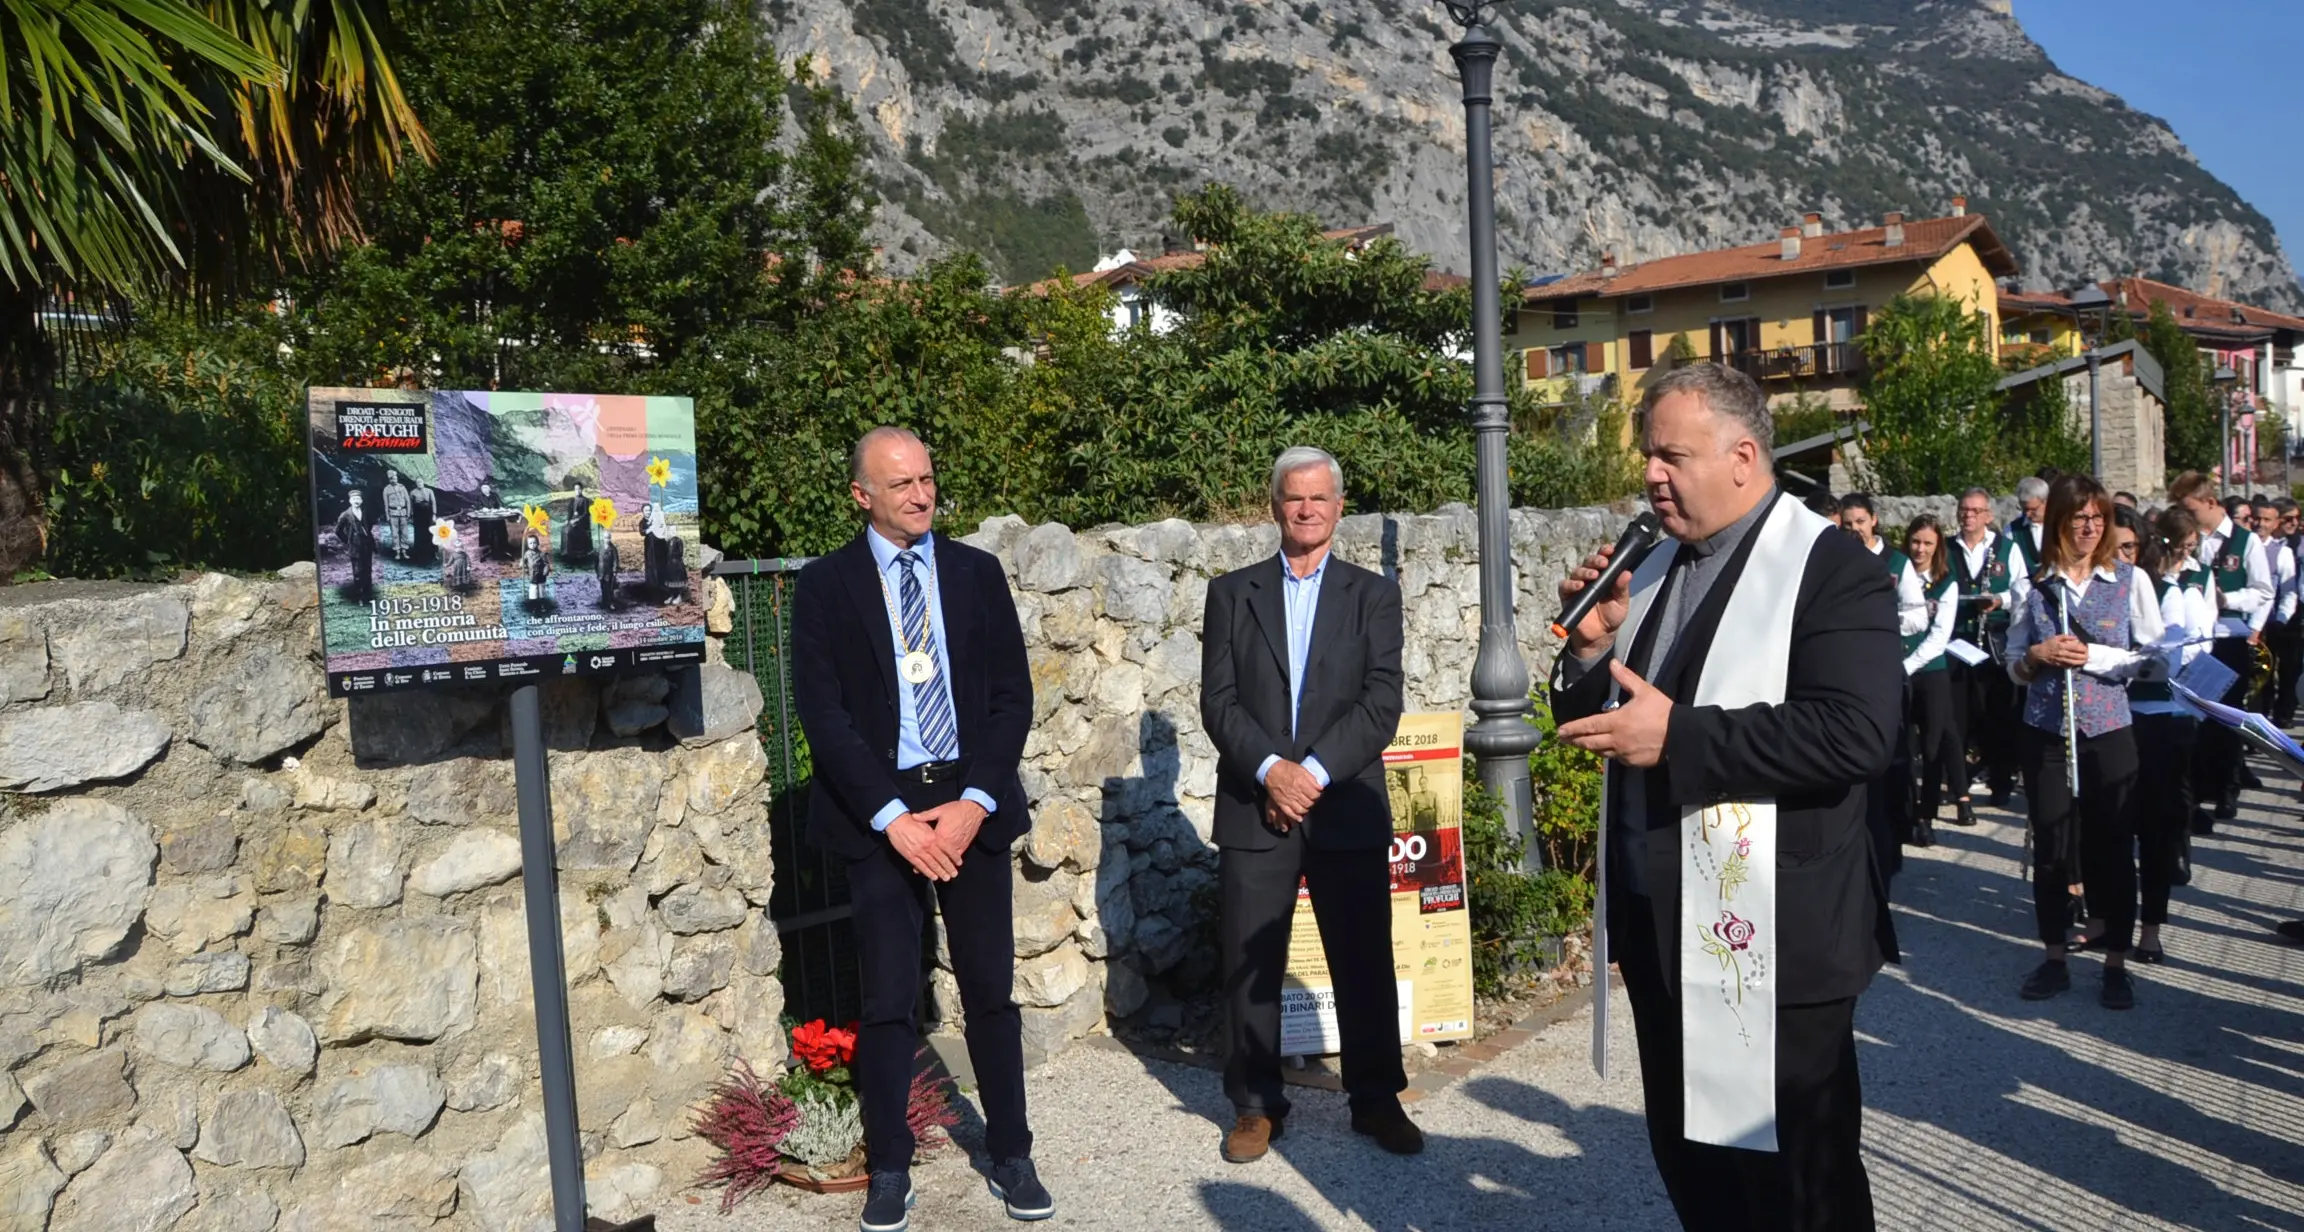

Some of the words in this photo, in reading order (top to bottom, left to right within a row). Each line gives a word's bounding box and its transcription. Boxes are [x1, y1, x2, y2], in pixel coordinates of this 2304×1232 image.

[346, 407, 375, 416] DROATI
[379, 408, 415, 417] CENIGOTI
[339, 415, 373, 424] DRENOTI
[345, 423, 419, 437] PROFUGHI
[369, 595, 462, 616] 1915-1918
[369, 616, 390, 632] In
[395, 611, 476, 630] memoria
[526, 616, 543, 625] che
[544, 613, 605, 624] affrontarono,
[371, 630, 417, 648] delle
[422, 623, 509, 644] Comunità
[527, 628, 544, 637] con
[545, 624, 578, 636] dignità
[587, 623, 611, 632] fede,
[611, 621, 618, 630] il
[619, 621, 645, 632] lungo
[1391, 734, 1412, 747] BRE
[1414, 733, 1439, 746] 2018
[1388, 835, 1427, 863] DO
[1389, 862, 1416, 875] -1918
[1316, 991, 1335, 1000] OTT
[1290, 1000, 1325, 1013] BINARI
